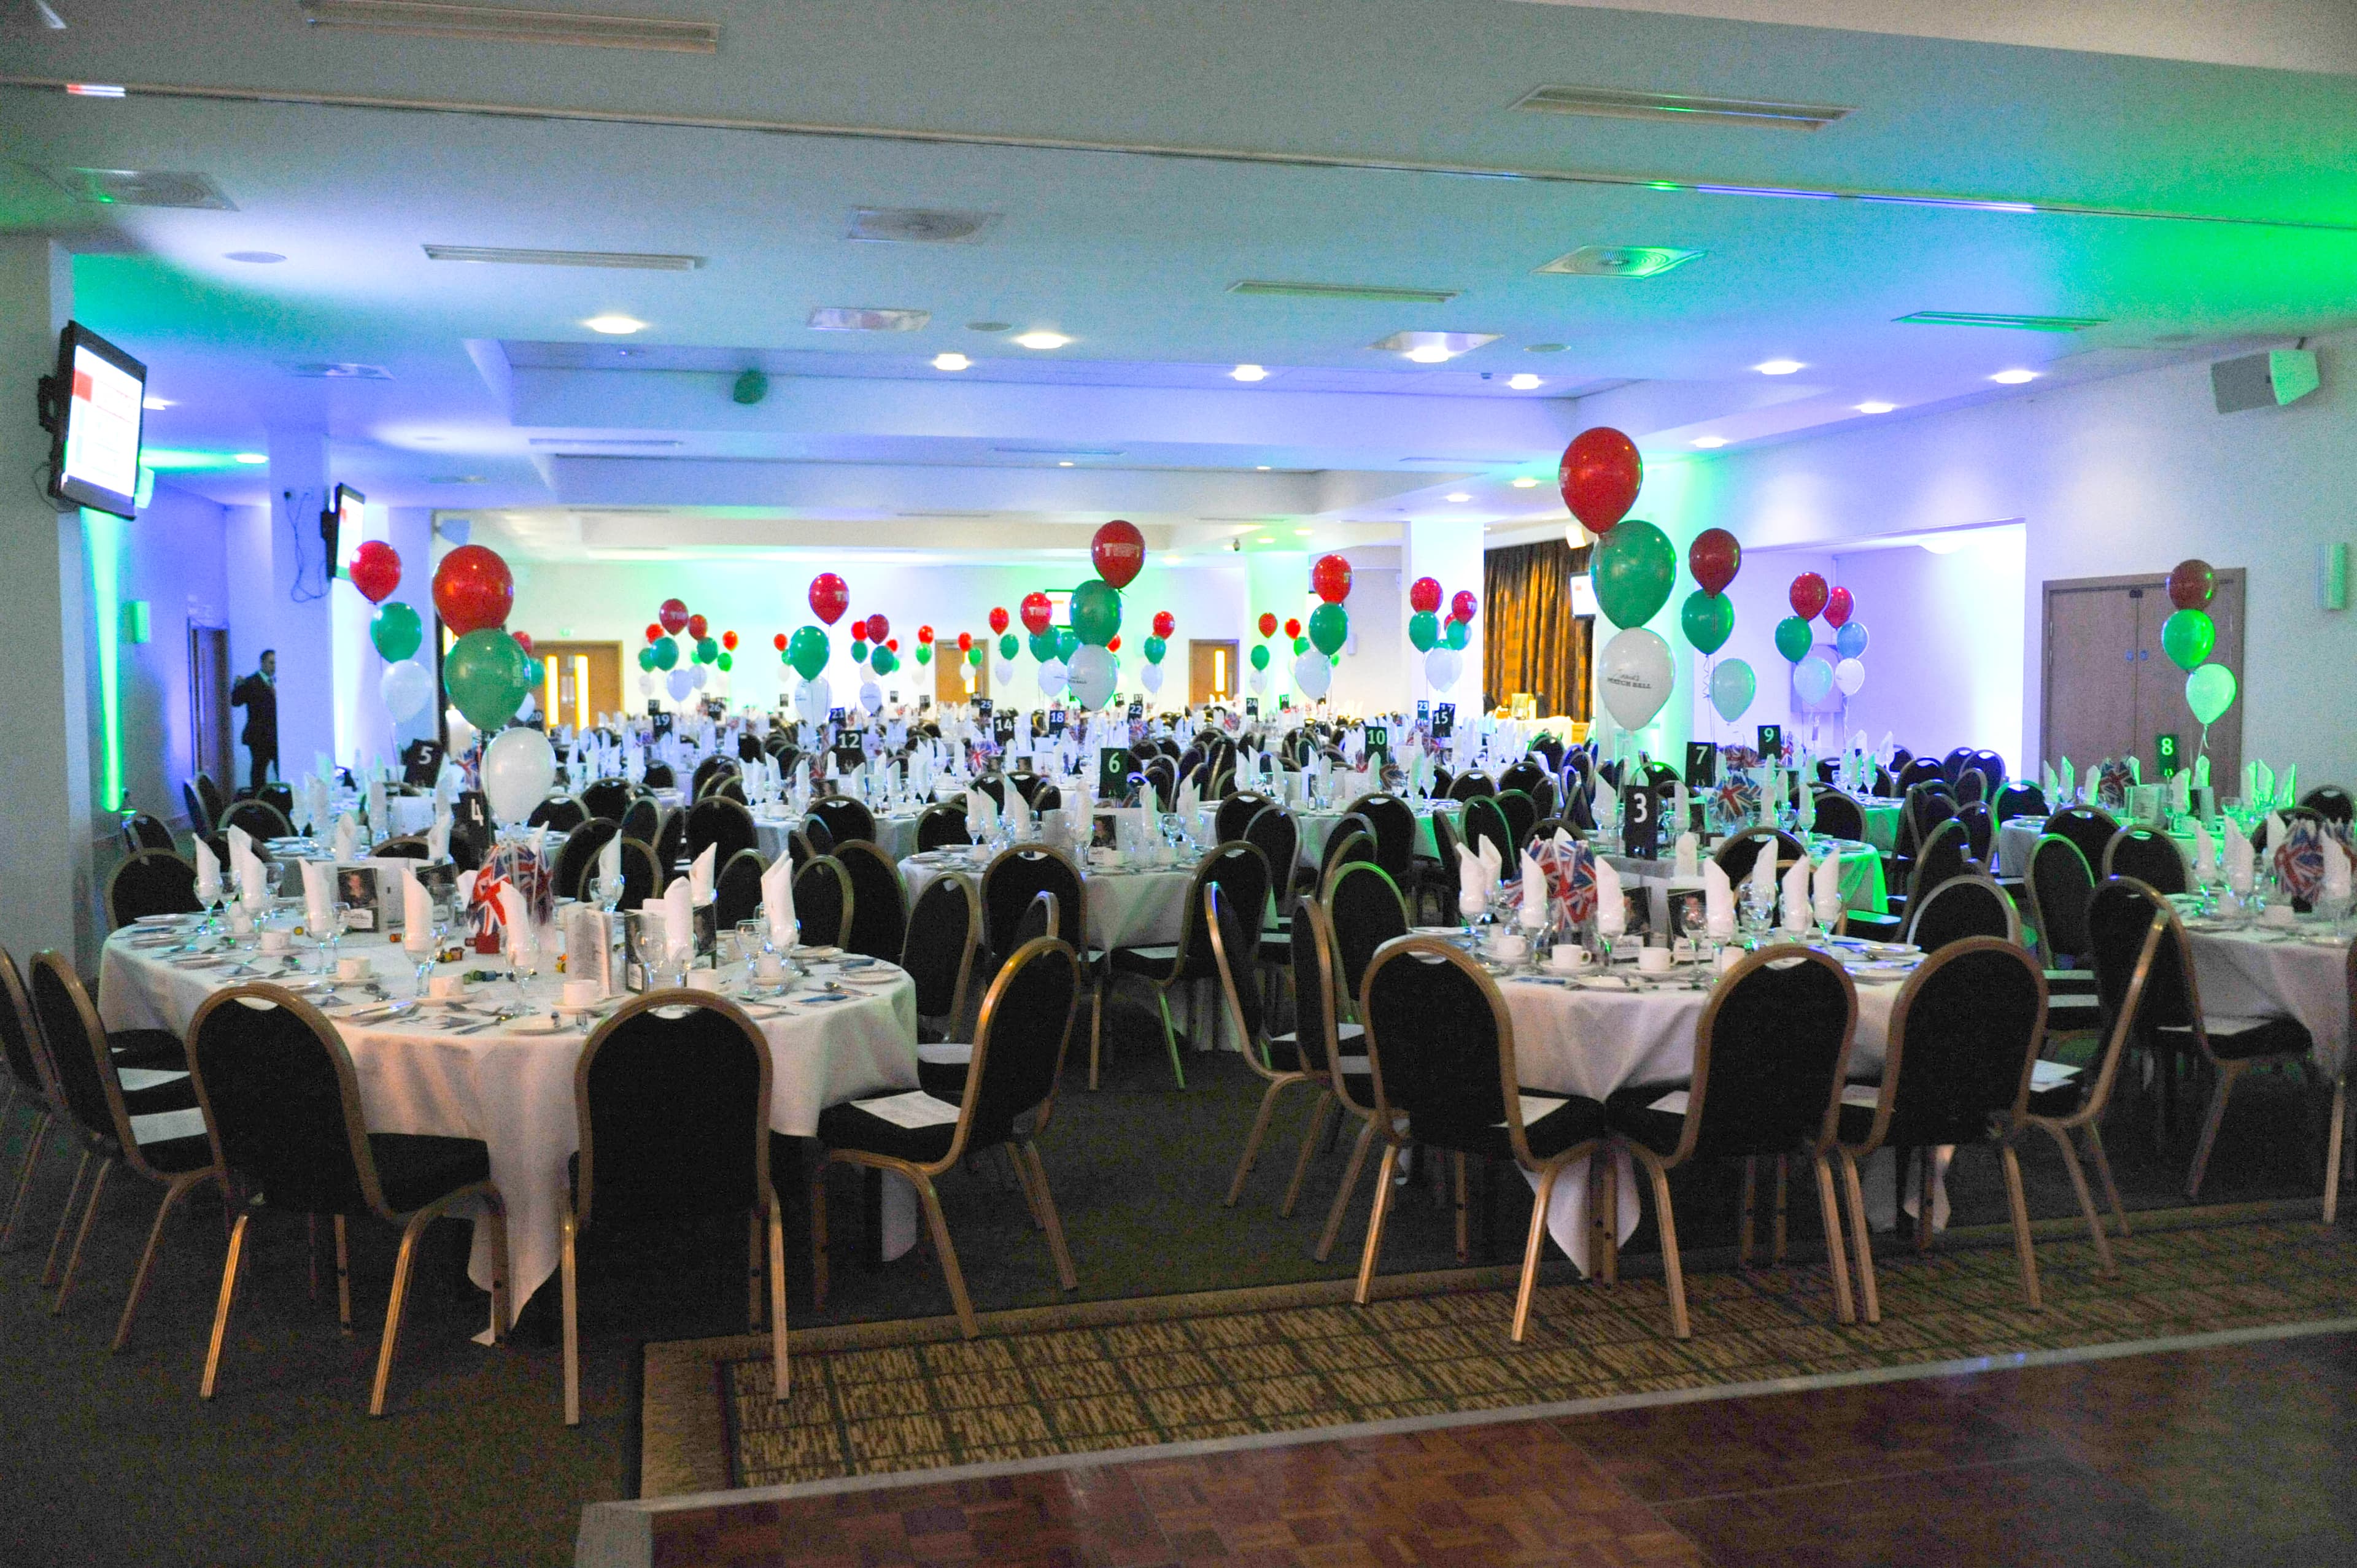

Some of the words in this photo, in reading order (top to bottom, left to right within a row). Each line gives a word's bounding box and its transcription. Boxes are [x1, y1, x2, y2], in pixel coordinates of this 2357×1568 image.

[708, 703, 720, 712] 26
[981, 700, 992, 709] 25
[1129, 705, 1142, 714] 22
[1418, 702, 1428, 711] 23
[654, 715, 670, 725] 19
[831, 710, 844, 719] 21
[1051, 712, 1064, 723] 18
[1434, 712, 1448, 724] 15
[996, 719, 1012, 732] 14
[838, 733, 860, 748] 12
[1368, 730, 1385, 745] 10
[1764, 728, 1774, 743] 9
[2162, 738, 2173, 755] 8
[419, 746, 433, 765] 5
[1109, 752, 1120, 773] 6
[1696, 746, 1708, 765] 7
[471, 798, 484, 826] 4
[1633, 794, 1647, 823] 3
